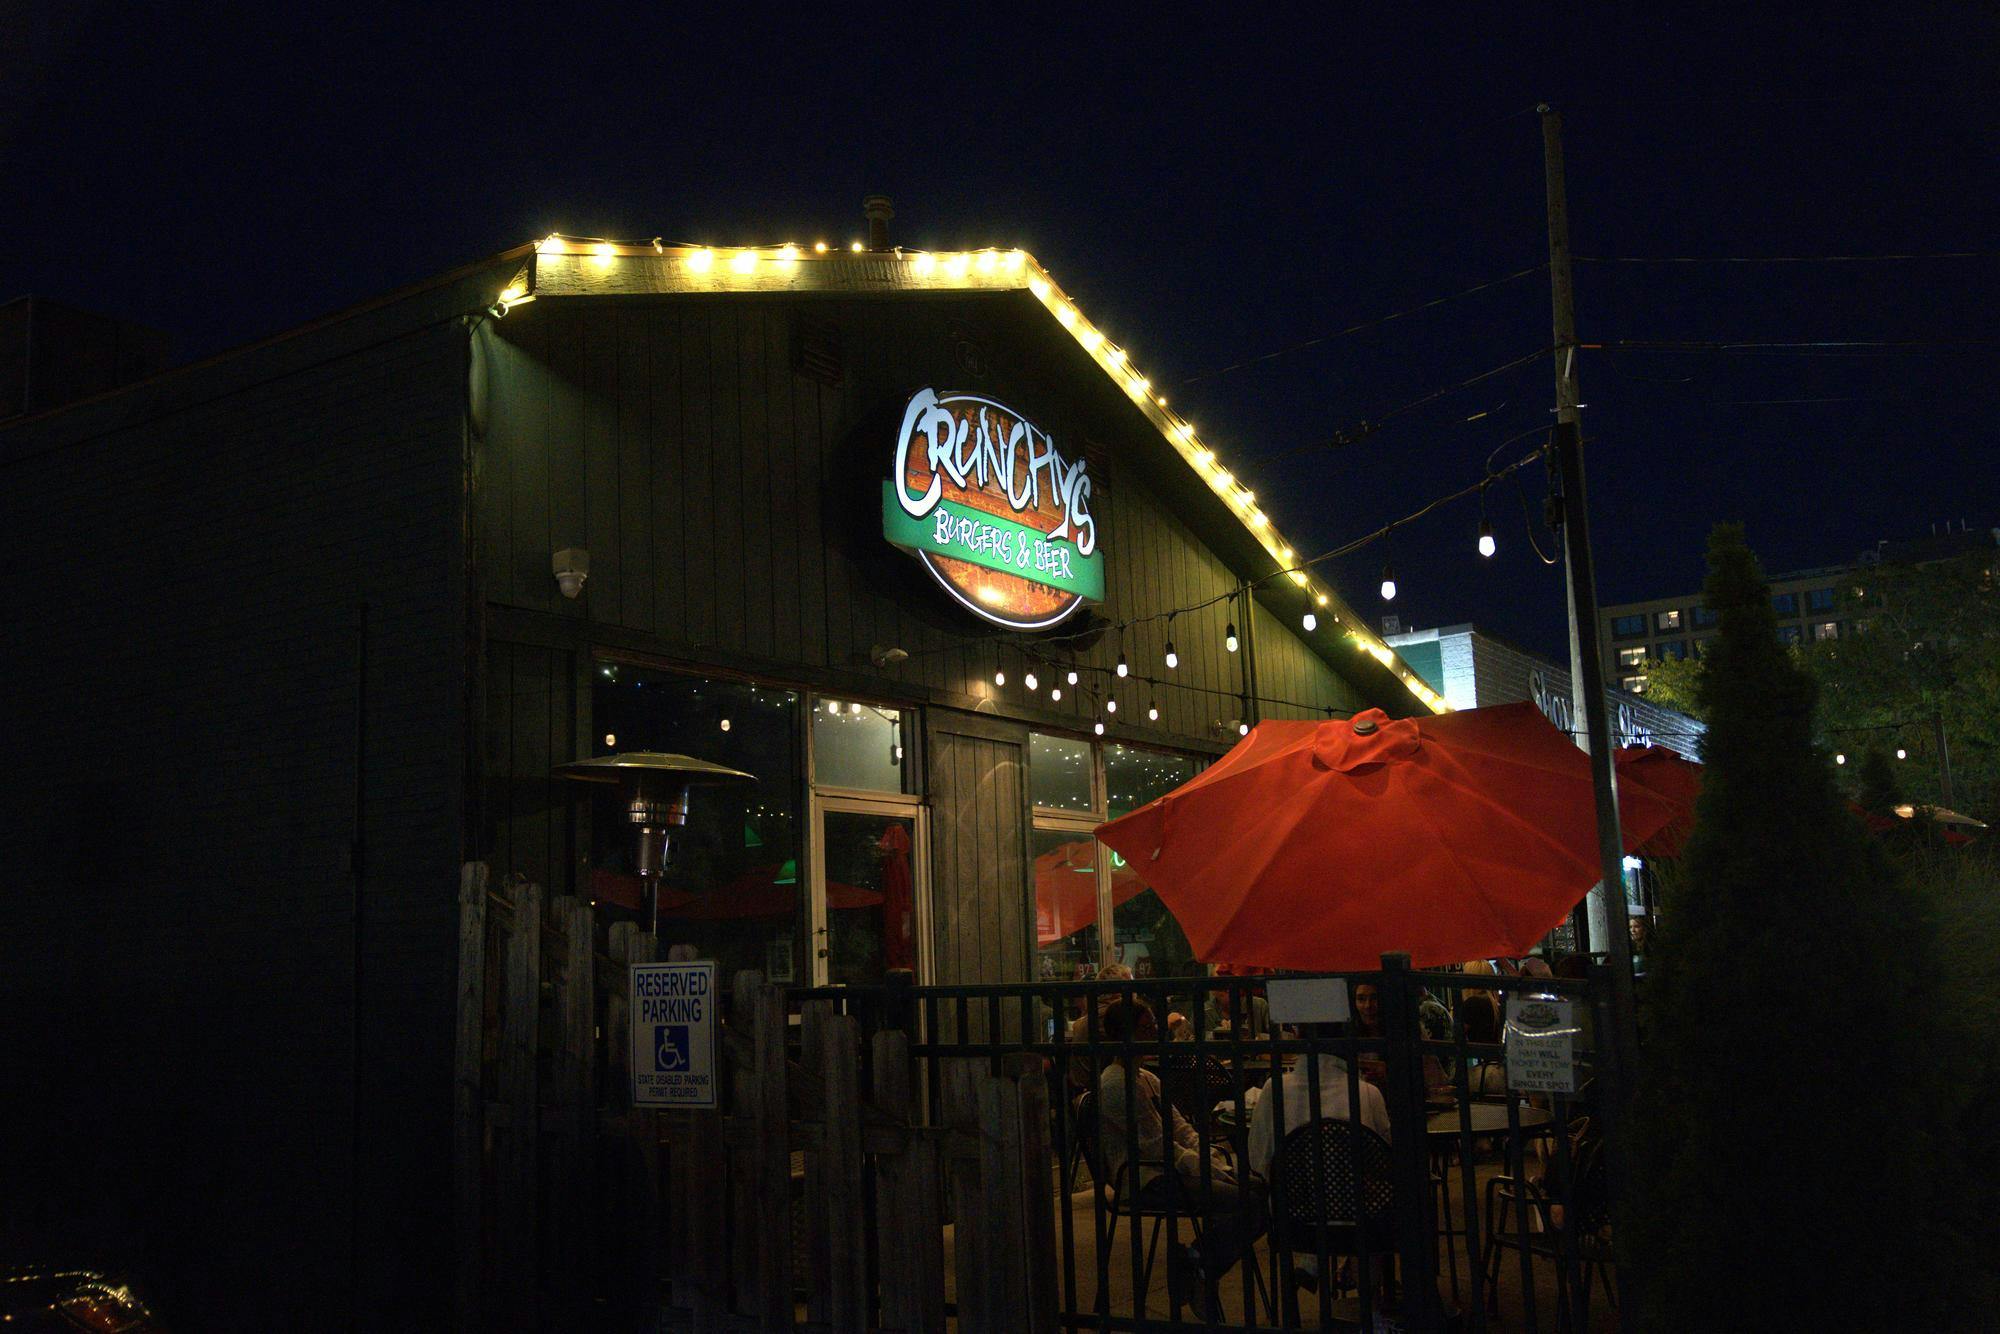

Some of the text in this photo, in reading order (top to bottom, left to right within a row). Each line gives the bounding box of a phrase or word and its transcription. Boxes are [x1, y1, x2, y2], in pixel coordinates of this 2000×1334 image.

[933, 507, 1074, 579] BURGERS & BEER
[637, 972, 708, 996] RESERVED
[642, 998, 702, 1022] PARKING
[1539, 1050, 1560, 1059] WILL
[638, 1074, 709, 1085] STATE DISABLED PARKING
[1526, 1070, 1555, 1079] EVERY
[1512, 1079, 1570, 1090] SINGLE SPOT
[648, 1087, 698, 1097] PERMIT REQUIRED
